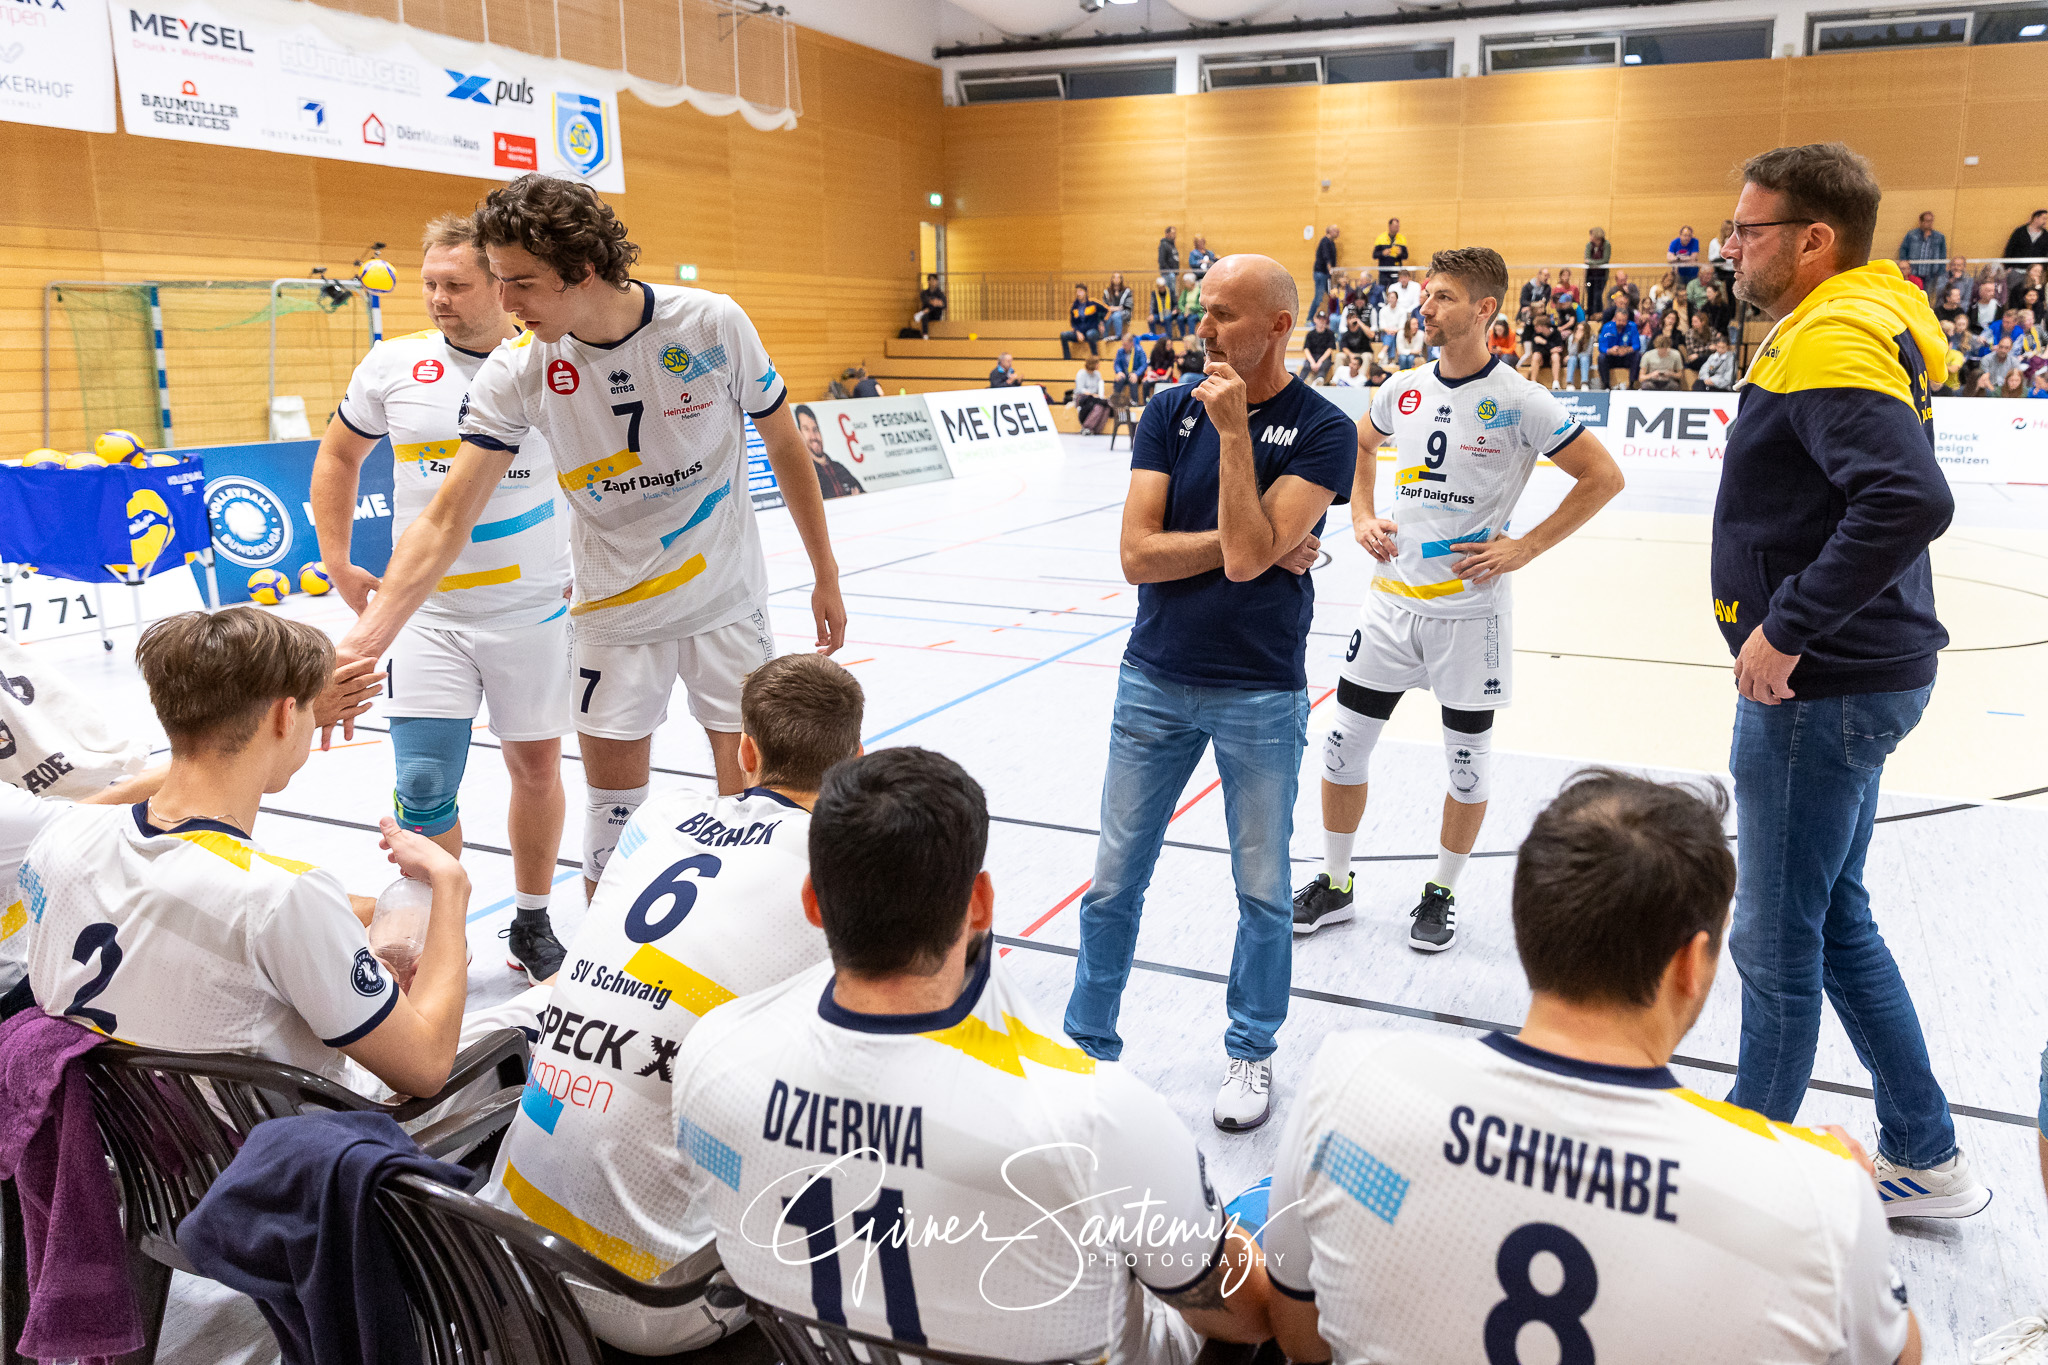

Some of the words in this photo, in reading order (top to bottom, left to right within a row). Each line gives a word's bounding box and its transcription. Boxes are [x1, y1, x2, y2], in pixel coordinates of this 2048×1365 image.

[130, 9, 254, 53] MEYSEL
[611, 400, 644, 453] 7
[663, 400, 713, 417] Heinzelmann
[872, 410, 927, 428] PERSONAL
[940, 402, 1048, 444] MEYSEL
[880, 428, 932, 446] TRAINING
[1425, 430, 1447, 469] 9
[1460, 444, 1500, 454] Heinzelmann
[1622, 444, 1681, 458] Druck
[1936, 446, 1974, 455] esign
[1939, 432, 1980, 441] Druck
[430, 460, 451, 473] Za
[602, 478, 636, 494] Zapf
[639, 461, 703, 487] Daigfuss
[210, 487, 272, 519] VOLLEYBALL
[1401, 486, 1422, 499] Zapf
[1424, 488, 1475, 504] Daigfuss
[48, 594, 98, 624] 71
[1346, 629, 1361, 663] 9
[579, 667, 601, 713] 7
[624, 853, 722, 944] 6
[63, 922, 123, 1035] 2
[570, 958, 595, 981] SV
[591, 965, 673, 1011] Schwaig
[540, 1004, 639, 1070] PECK
[763, 1079, 925, 1169] DZIERWA
[1443, 1105, 1681, 1223] SCHWABE
[781, 1173, 928, 1349] 11
[1483, 1221, 1599, 1365] 8
